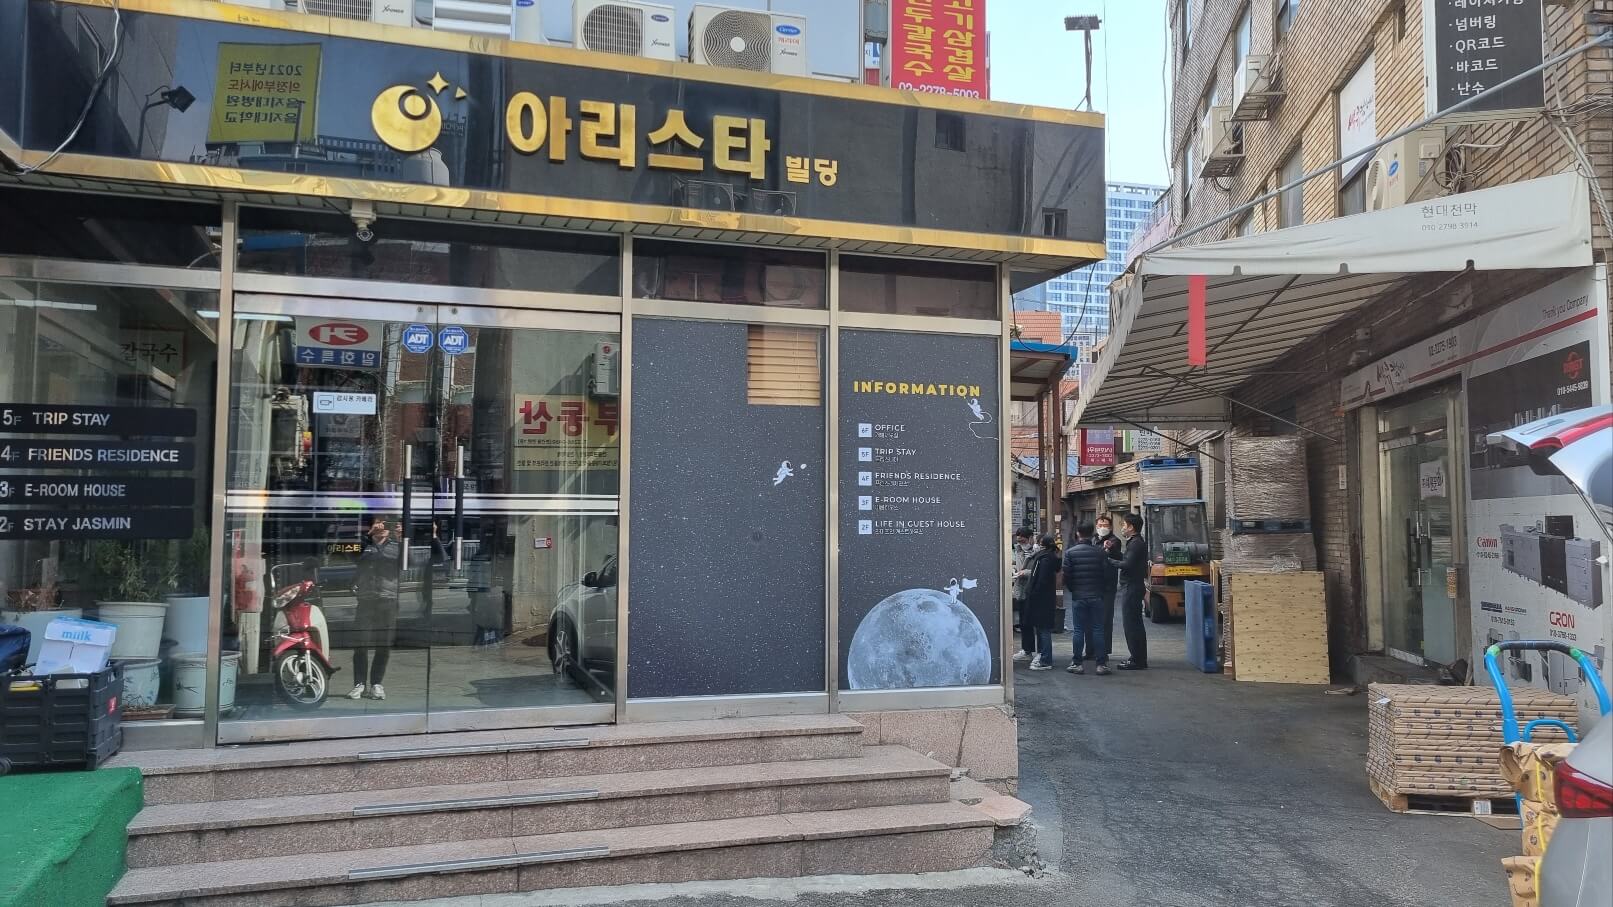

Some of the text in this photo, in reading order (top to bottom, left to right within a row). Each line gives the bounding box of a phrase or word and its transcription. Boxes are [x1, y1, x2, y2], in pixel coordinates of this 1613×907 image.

[1455, 15, 1497, 32] 넘버링
[1455, 36, 1505, 52] QR코드
[1456, 58, 1498, 73] 바코드
[1457, 81, 1485, 97] 난수
[505, 91, 839, 187] 아리스타 빌딩
[407, 333, 429, 345] ADT
[442, 334, 465, 346] ADT
[853, 380, 981, 397] INFORMATION
[2, 409, 111, 427] 5F TRIP STAY
[874, 424, 906, 432] OFFICE
[0, 445, 180, 463] 4F FRIENDS RESIDENCE
[896, 448, 917, 456] STAY
[875, 472, 912, 480] FRIENDS
[914, 473, 961, 481] RESIDENCE
[24, 483, 79, 497] E-ROOM
[84, 484, 126, 497] HOUSE
[912, 496, 942, 504] HOUSE
[23, 518, 69, 531] STAY
[72, 517, 131, 531] JASMIN
[875, 520, 894, 528] LIFE
[907, 520, 935, 528] GUEST
[1476, 536, 1498, 548] Canon
[1549, 611, 1575, 629] CRON
